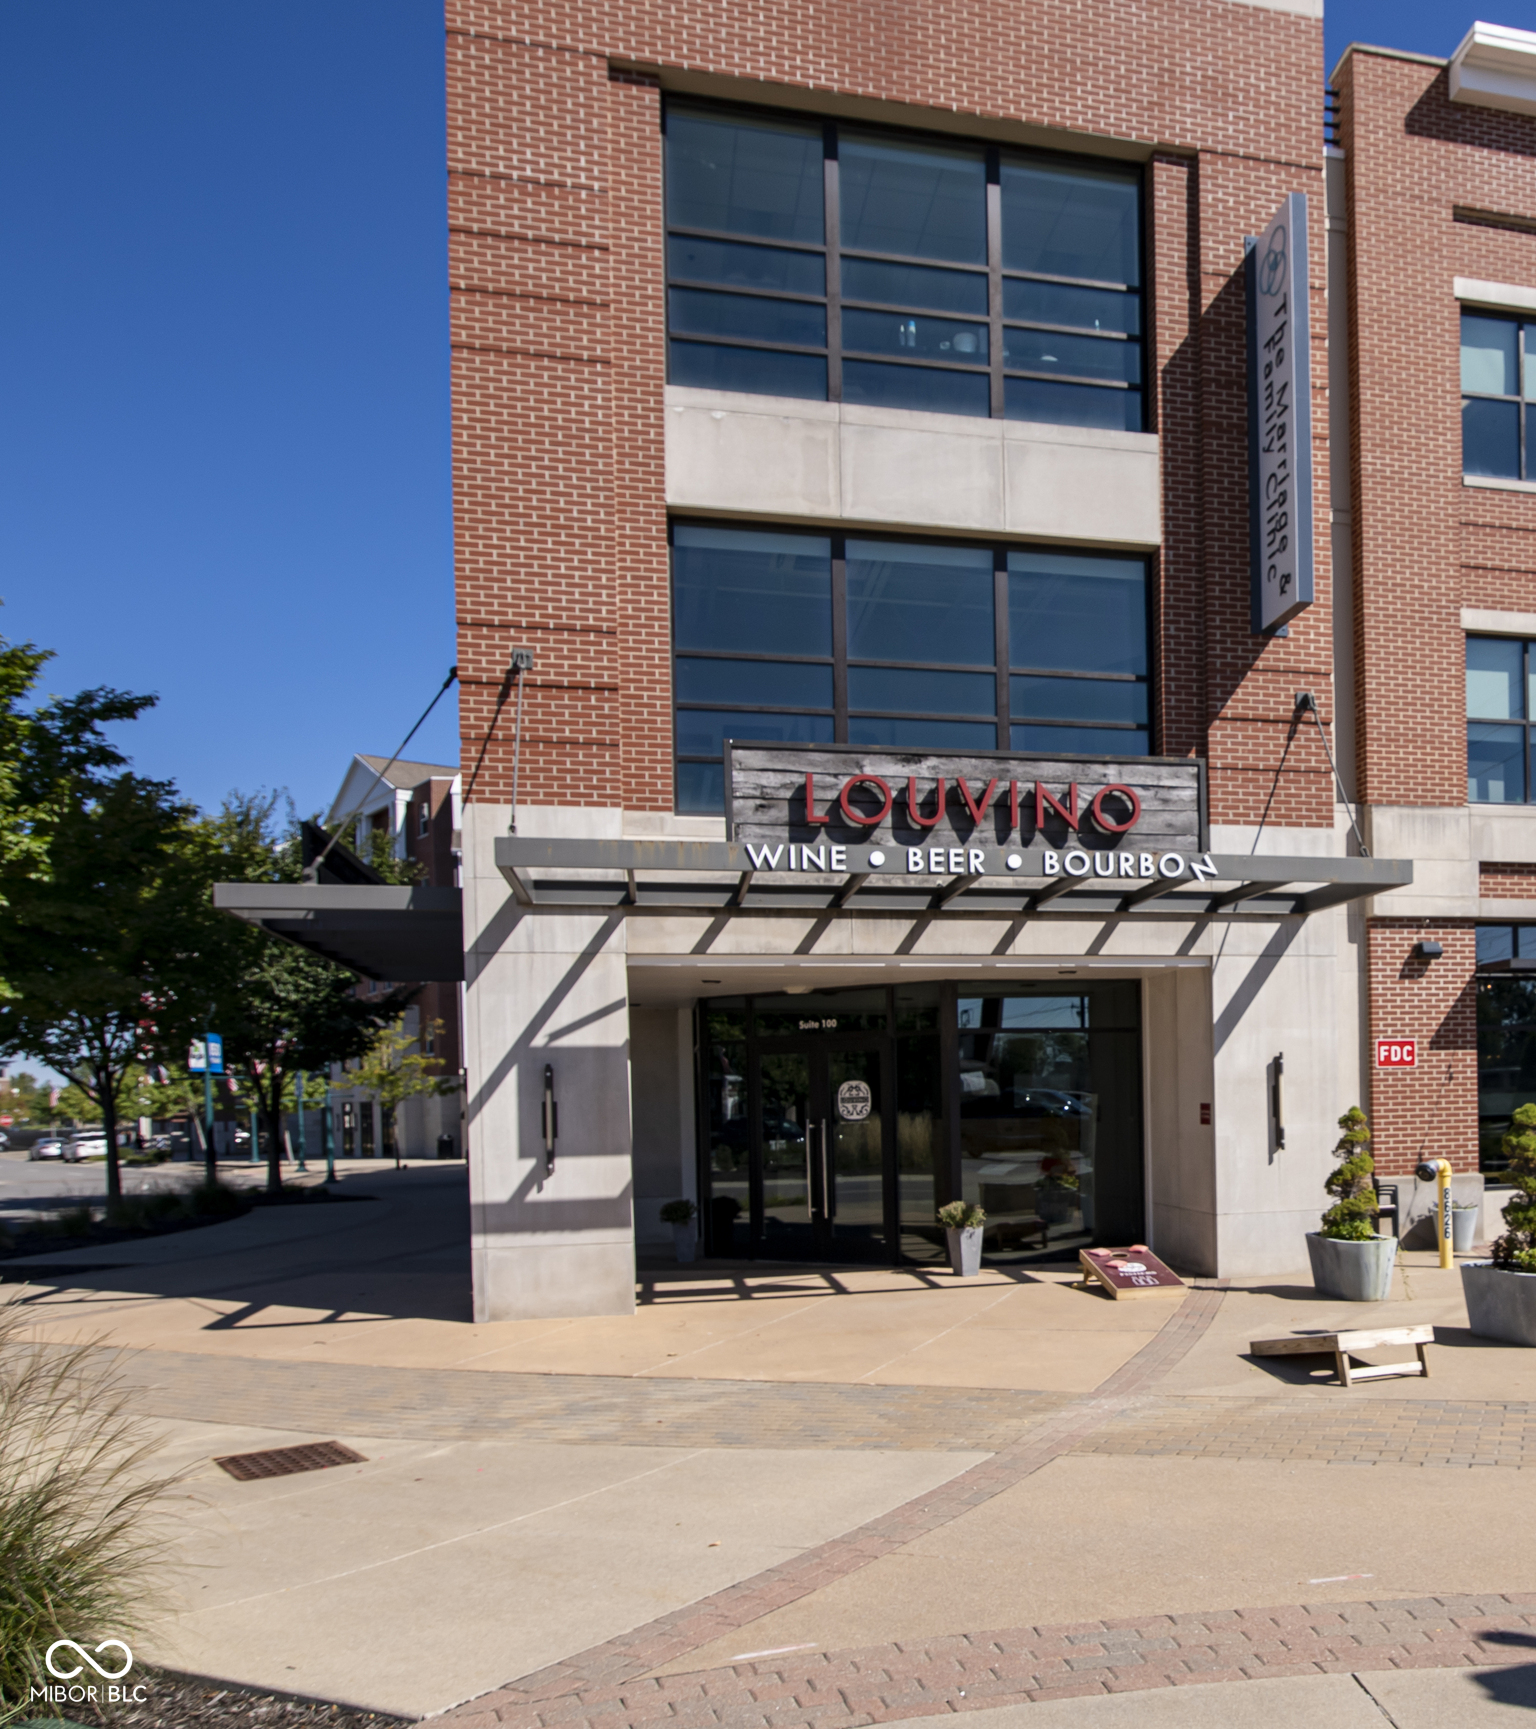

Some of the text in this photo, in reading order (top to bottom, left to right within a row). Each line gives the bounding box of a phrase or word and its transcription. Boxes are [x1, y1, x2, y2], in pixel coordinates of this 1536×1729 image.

[1262, 334, 1279, 583] Family Clinic
[1274, 292, 1291, 597] The Marriage &
[805, 772, 1142, 833] LOUVINO
[745, 843, 1219, 883] WINE BEER BOURBON
[799, 1019, 837, 1029] Suite 100
[1380, 1045, 1413, 1062] FDC
[1443, 1187, 1451, 1239] 8626
